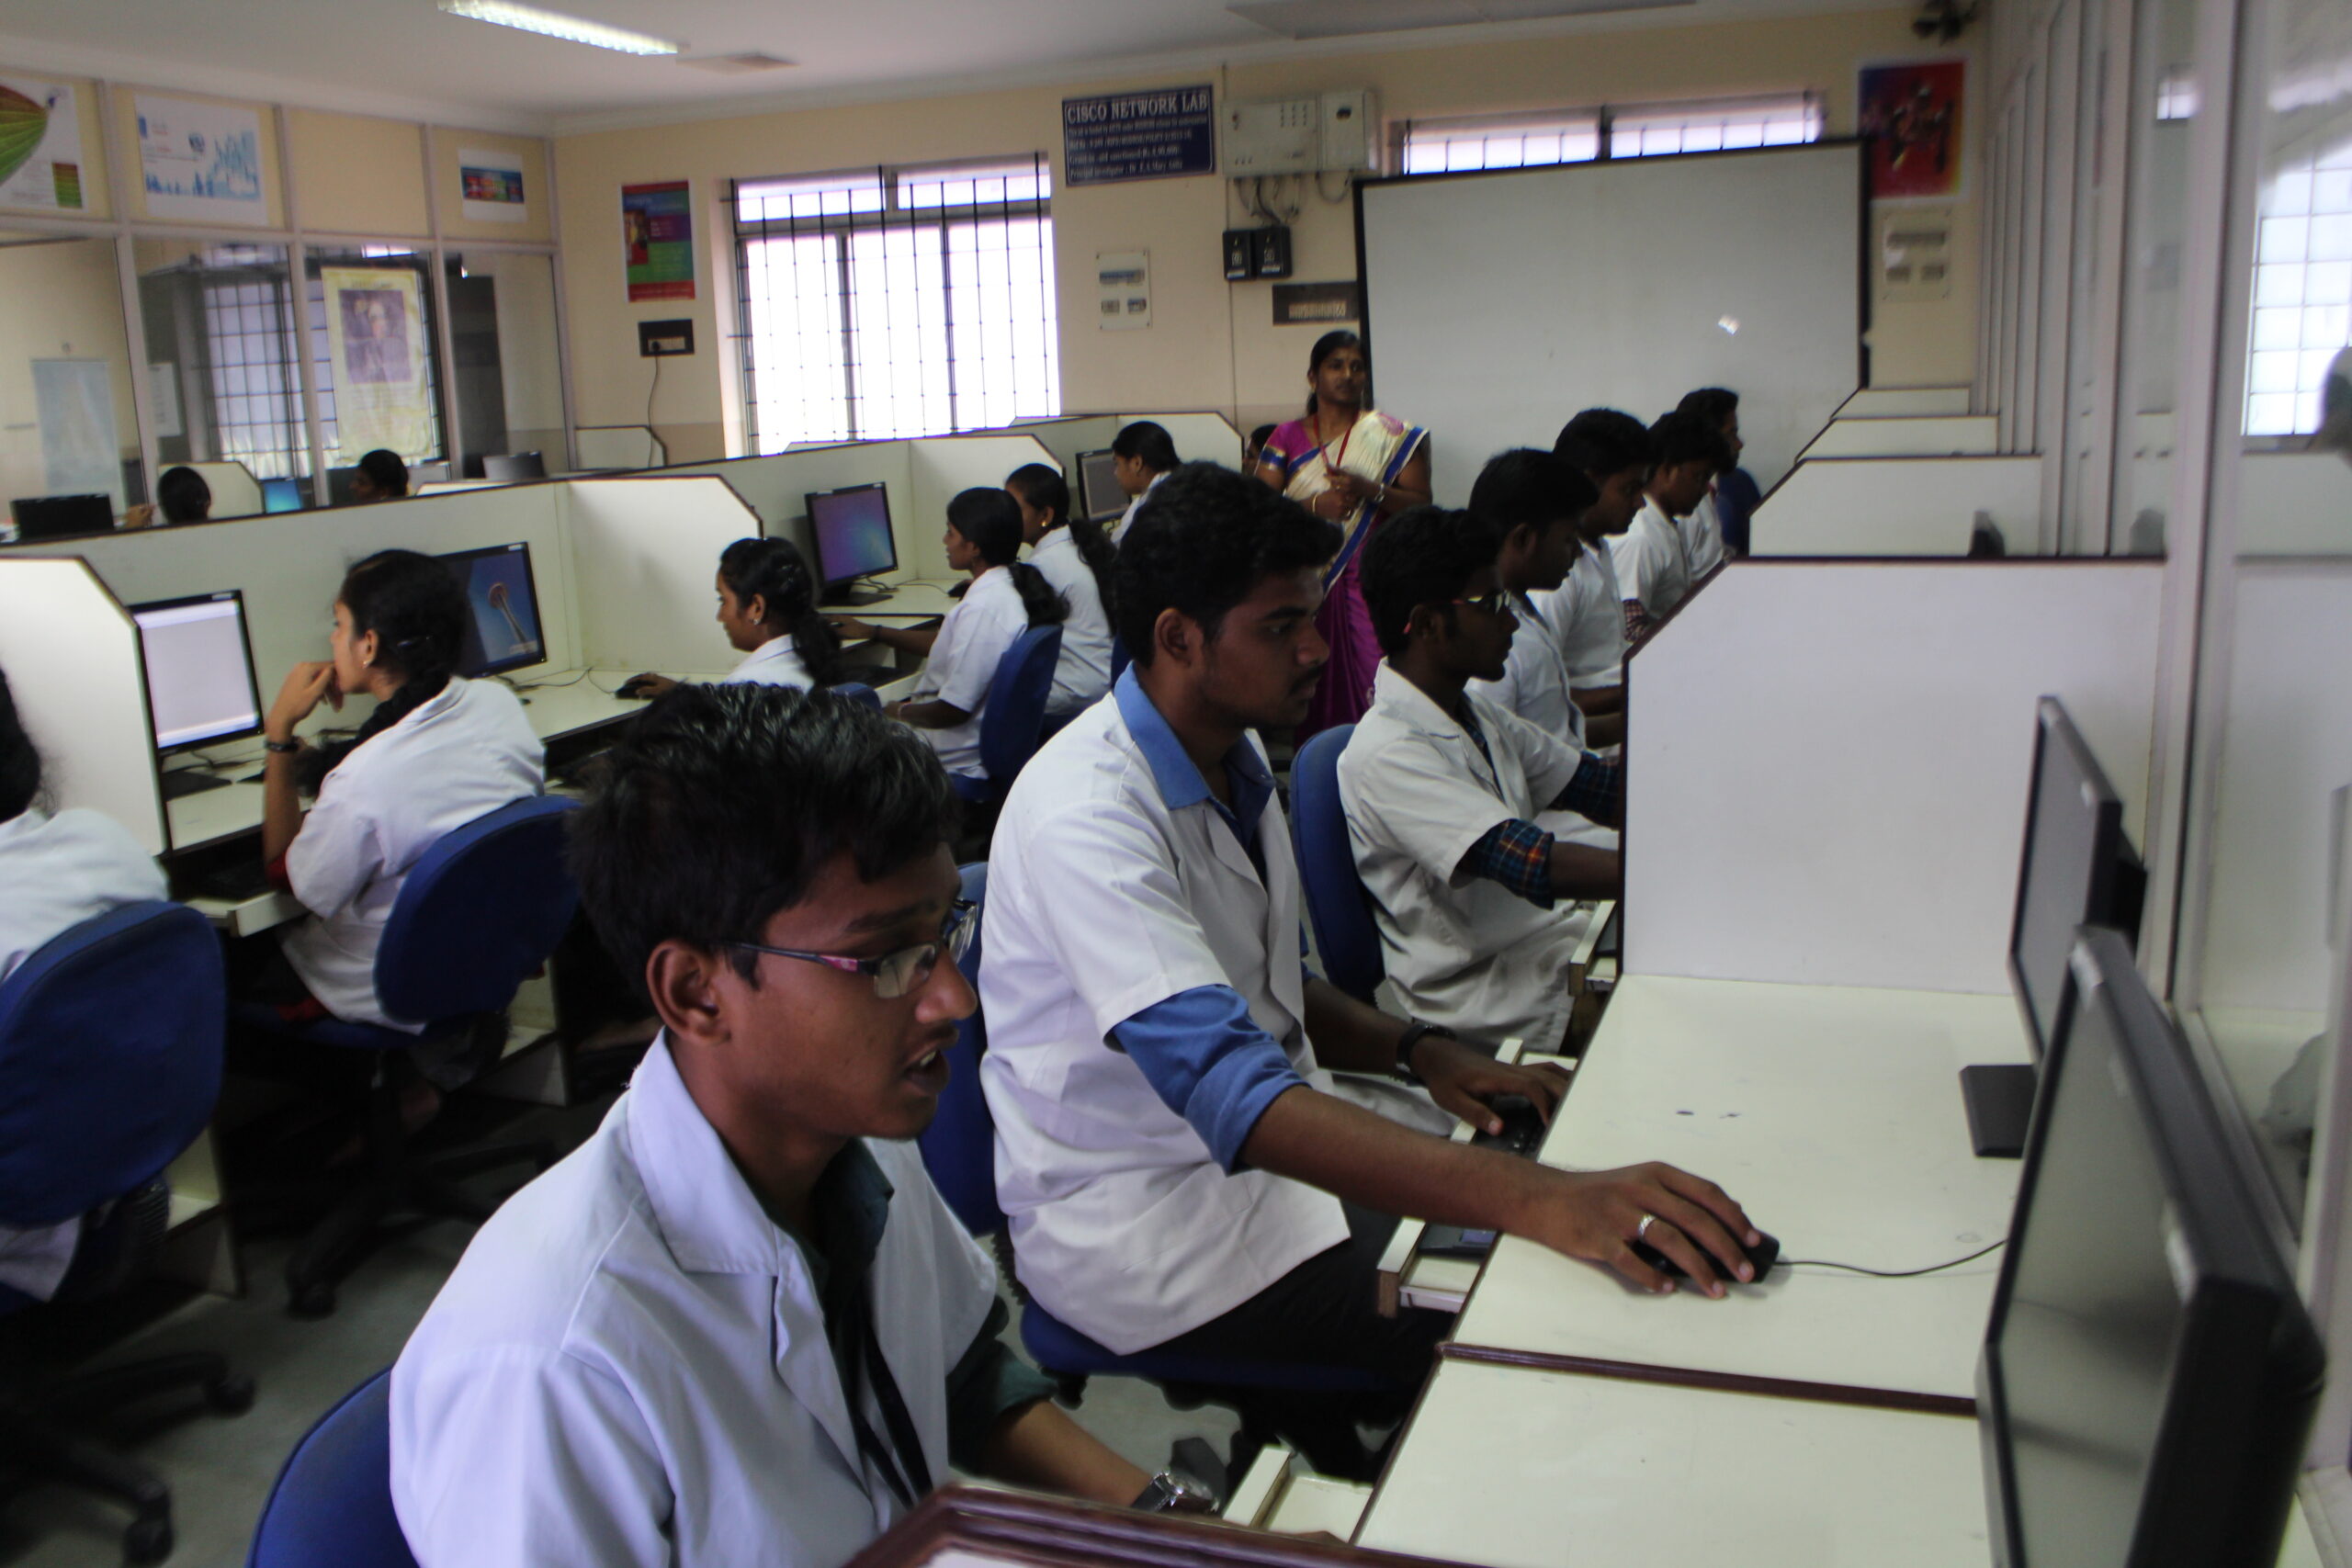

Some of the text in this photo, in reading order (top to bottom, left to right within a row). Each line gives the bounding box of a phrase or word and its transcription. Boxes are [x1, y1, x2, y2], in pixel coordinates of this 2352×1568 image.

[1067, 93, 1207, 124] CISCO NETWORK LAB
